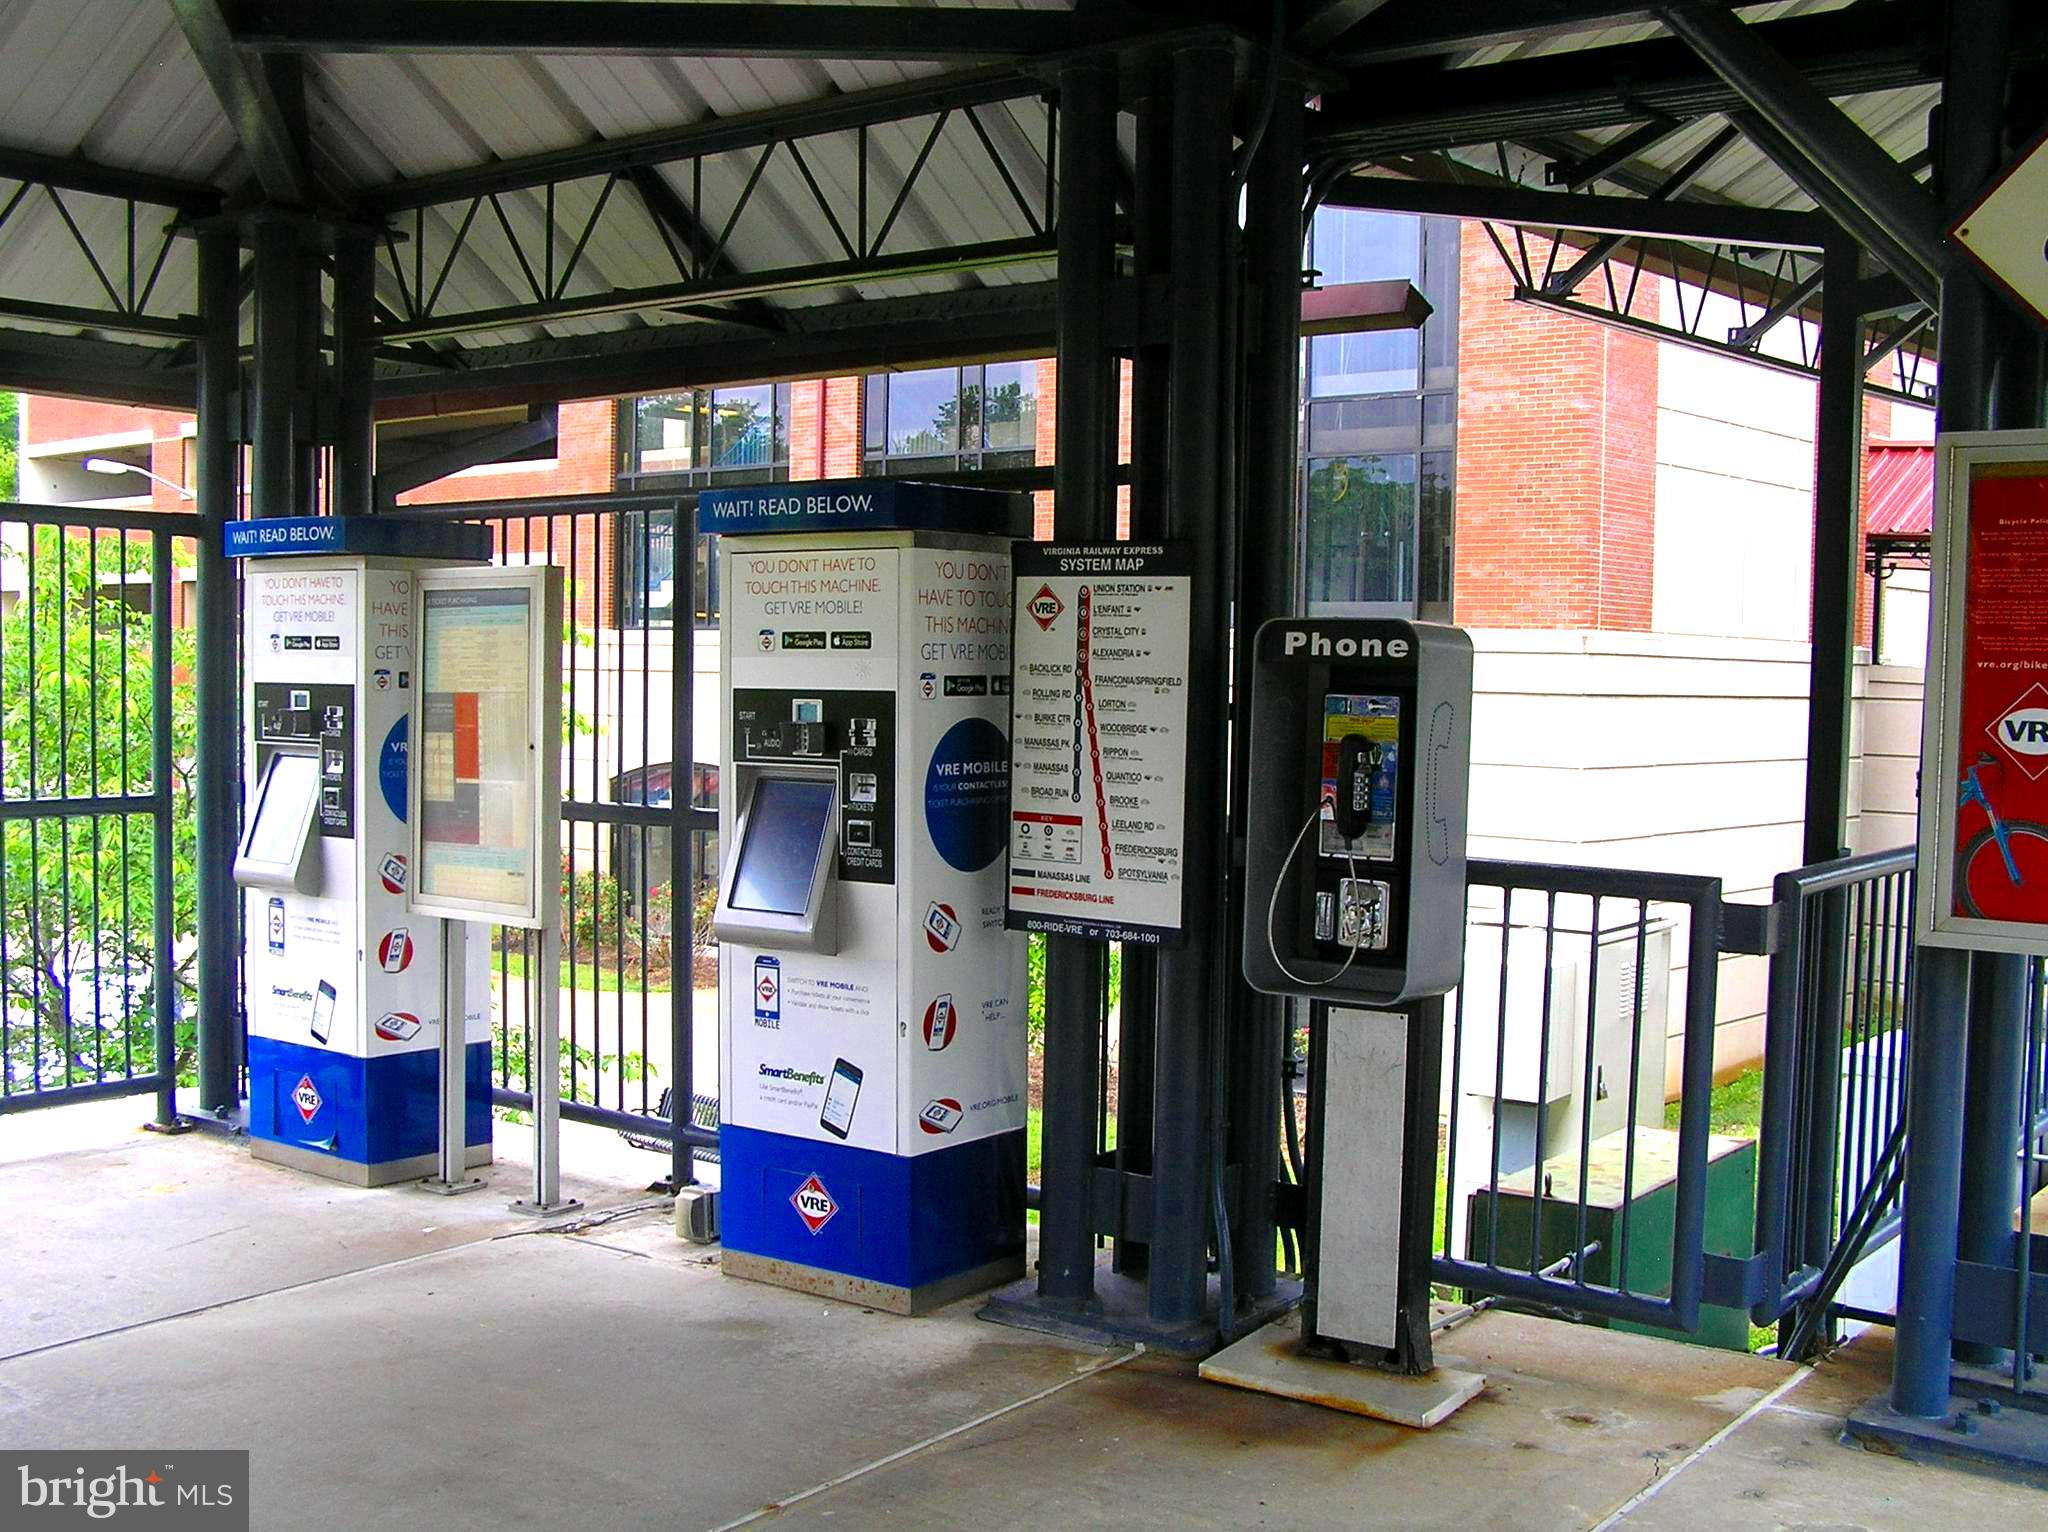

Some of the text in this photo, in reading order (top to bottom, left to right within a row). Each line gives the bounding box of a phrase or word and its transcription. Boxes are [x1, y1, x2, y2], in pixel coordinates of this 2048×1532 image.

[713, 495, 873, 518] WAIT! READ BELOW.
[233, 526, 335, 544] WAIT! READ BELOW.
[1083, 547, 1121, 555] RAILWAY
[1123, 546, 1163, 554] EXPRESS
[749, 557, 875, 573] YOU DON'T HAVE TO
[1060, 558, 1144, 571] SYSTEM MAP
[935, 562, 964, 580] YOU
[264, 576, 343, 590] YOU DON'T HAVE TO
[390, 580, 408, 594] YO
[745, 578, 880, 595] TOUCH THIS MACHINE.
[262, 594, 287, 606] TOUCH
[288, 594, 305, 606] THIS
[918, 590, 1012, 608] HAVE TO TOUC
[373, 601, 407, 616] HAVE
[764, 600, 863, 615] GET VRE MOBILE!
[1034, 603, 1056, 614] VRE
[1093, 606, 1124, 614] L'ENFANT
[273, 610, 335, 623] GET VRE MOBILE!
[379, 624, 409, 638] THIS
[925, 616, 1009, 635] THIS MACHIN
[1093, 628, 1123, 636] CRYSTAL
[795, 638, 824, 647] Google Play
[1284, 632, 1409, 658] Phone
[376, 645, 399, 660] GET
[921, 643, 1008, 661] GET VRE MOBI
[1093, 649, 1134, 657] ALEXANDRIA
[1030, 664, 1061, 673] BACKLICK
[1095, 675, 1182, 686] FRANCONIA/SPRINGFIELD
[1032, 689, 1072, 698] ROLLING RD
[1099, 700, 1126, 708] LORTON
[739, 711, 756, 720] START
[1034, 714, 1071, 723] BURKE CTR
[1100, 725, 1147, 734] WOODBRIDGE
[2004, 720, 2048, 742] VR
[392, 743, 408, 752] VR
[1024, 738, 1070, 747] MANASSAS PK
[1103, 749, 1128, 757] RIPPON
[936, 761, 1008, 776] VRE MOBILE
[1033, 763, 1069, 772] MANASSAS
[1106, 772, 1142, 782] QUANTICO
[1031, 787, 1069, 797] BROAD RUN
[1110, 795, 1138, 806] BROOKE
[1112, 821, 1143, 831] LEELAND
[1144, 822, 1154, 831] RD
[1115, 844, 1178, 857] FREDERICKSBURG
[1037, 871, 1091, 883] MANASSAS LINE
[1118, 868, 1168, 880] SPOTSYLVANIA
[1037, 889, 1114, 904] FREDERICKSBURG LINE
[983, 920, 1004, 929] SWITC
[1027, 920, 1083, 934] 800-RIDE-VRE
[1105, 929, 1160, 943] 703-684-1001
[762, 985, 773, 993] VRE
[830, 982, 854, 991] MOBILE
[982, 998, 1009, 1009] VRE CAN
[754, 1018, 780, 1030] MOBILE
[759, 1064, 825, 1085] SmartBenefits
[299, 1092, 317, 1106] VRE
[801, 1195, 829, 1214] VRE
